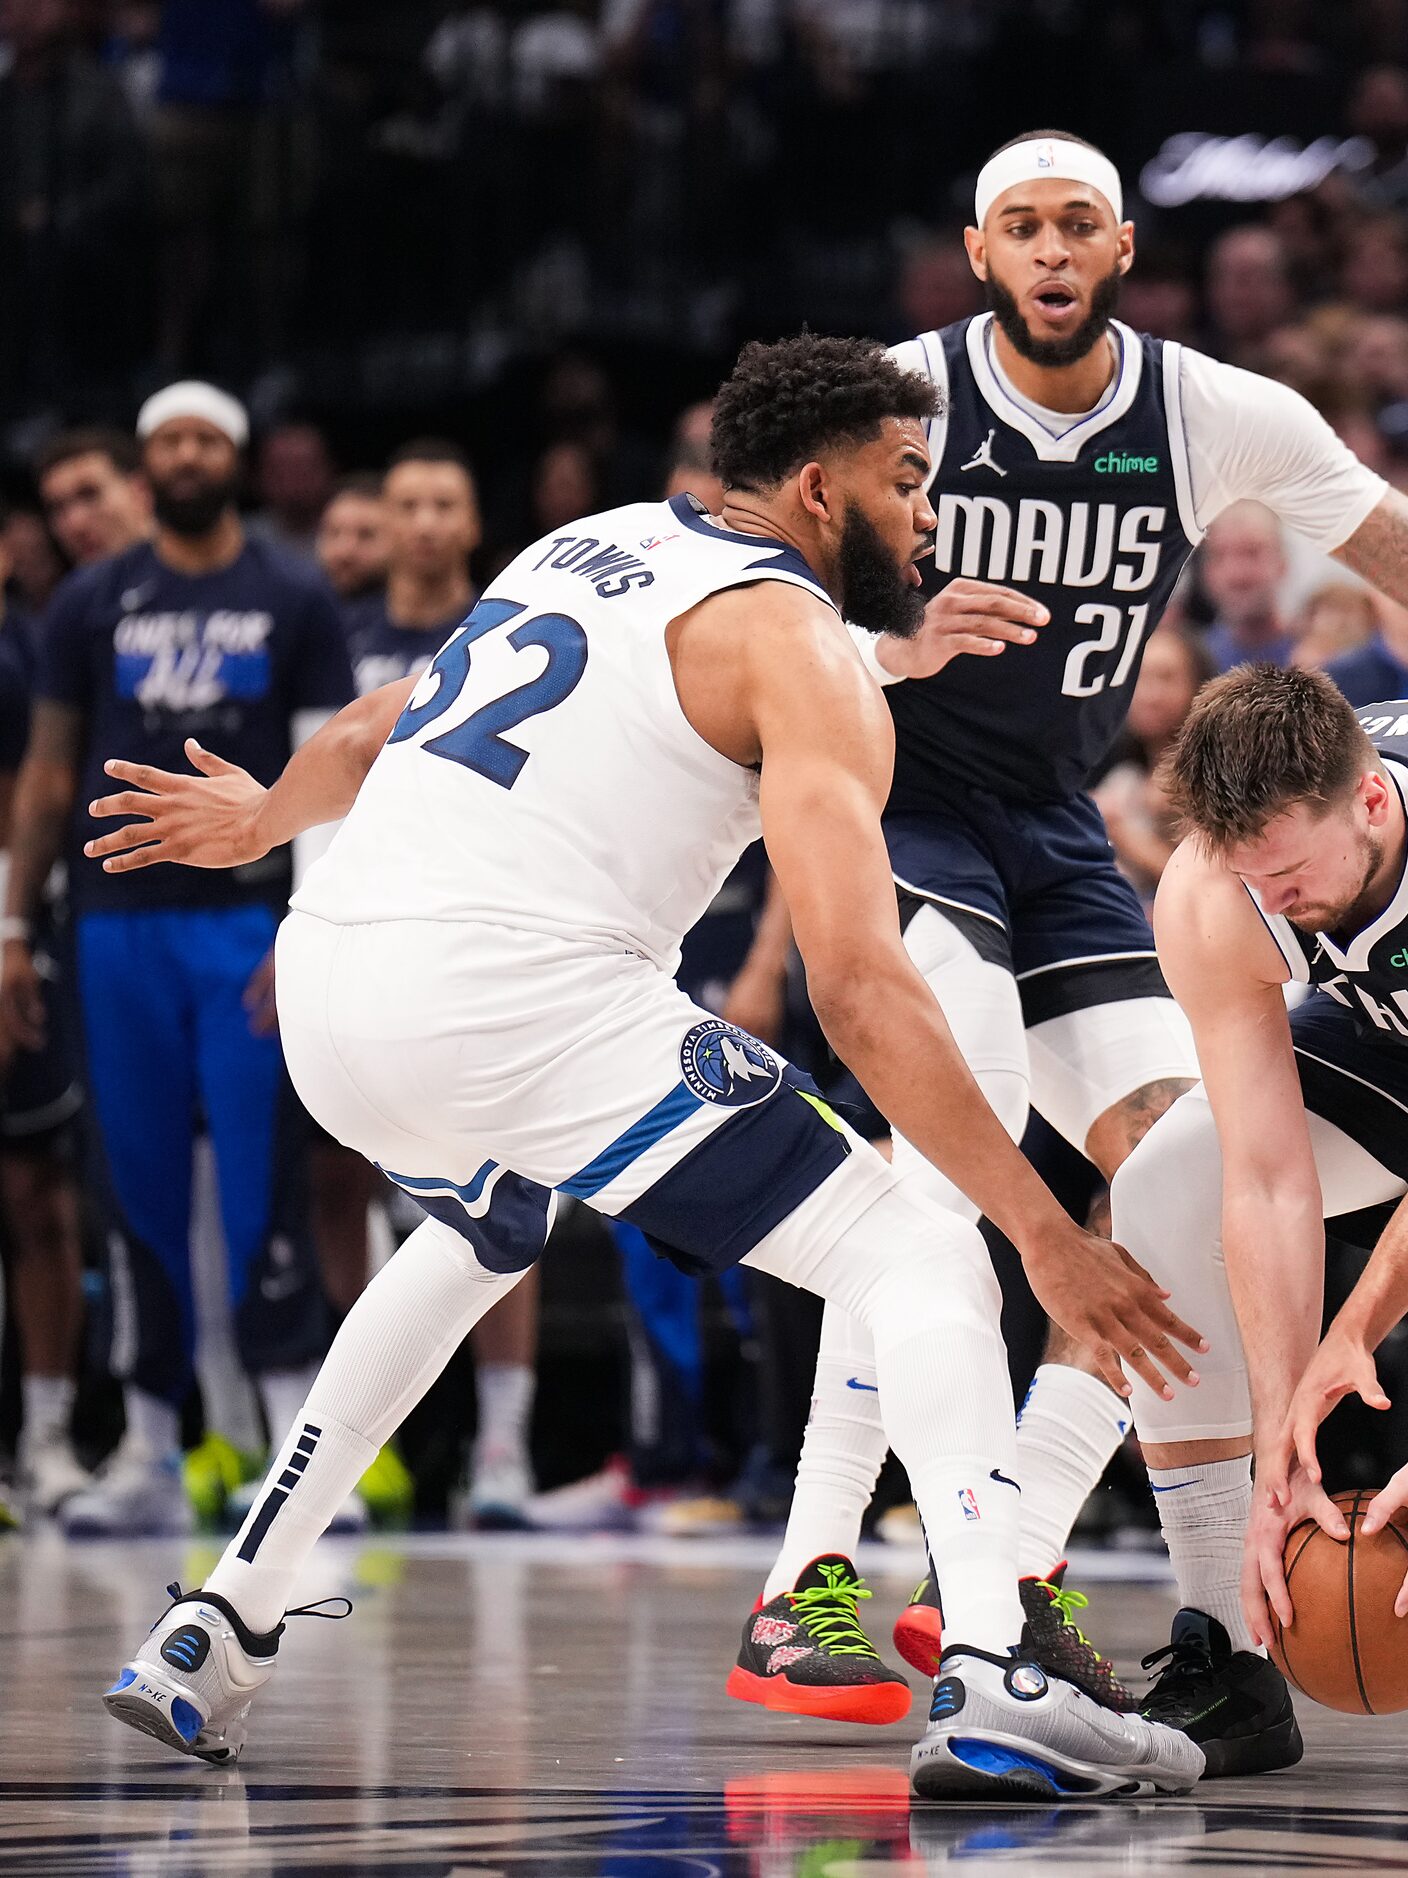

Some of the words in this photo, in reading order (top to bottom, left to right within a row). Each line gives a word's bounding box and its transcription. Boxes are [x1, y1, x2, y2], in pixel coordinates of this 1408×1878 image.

[1094, 451, 1159, 475] chime
[935, 493, 1167, 593] MAVS
[386, 597, 588, 791] 32
[1060, 602, 1149, 698] 21
[682, 1033, 717, 1101] MINNESOTA
